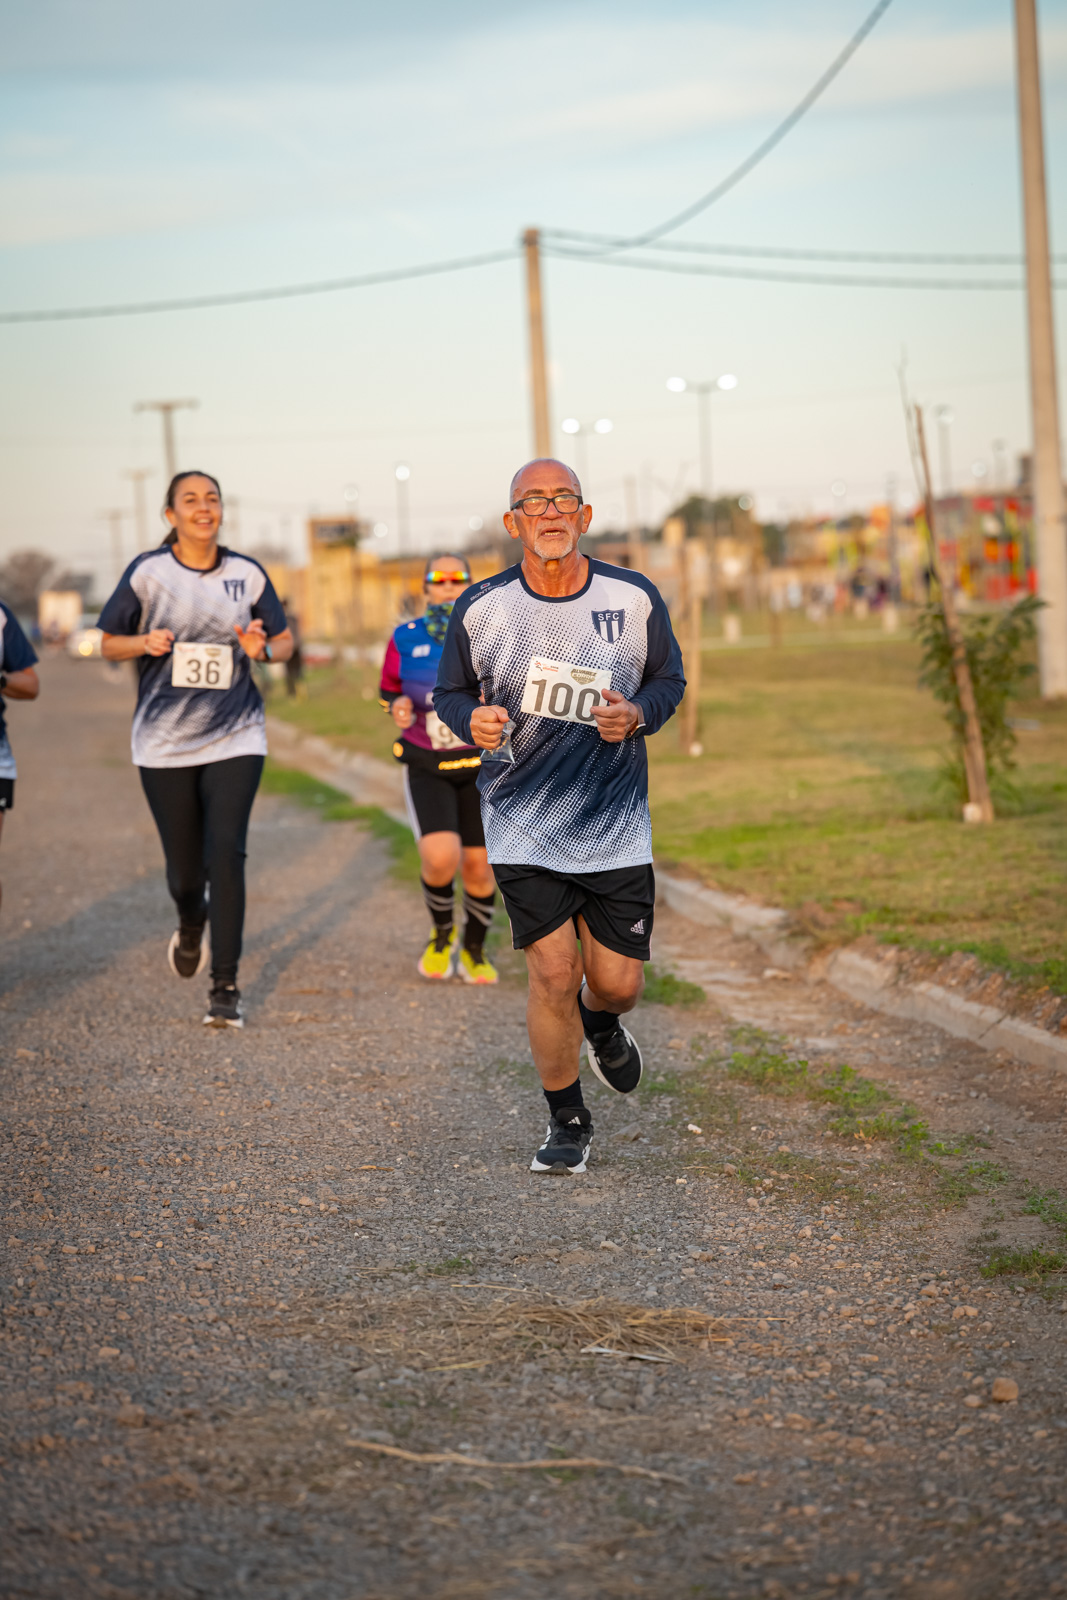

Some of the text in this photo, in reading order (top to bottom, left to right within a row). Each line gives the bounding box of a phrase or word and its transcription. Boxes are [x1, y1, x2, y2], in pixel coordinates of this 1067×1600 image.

[597, 612, 620, 621] SFC
[186, 659, 220, 685] 36
[531, 678, 601, 722] 100
[630, 926, 644, 934] adida
